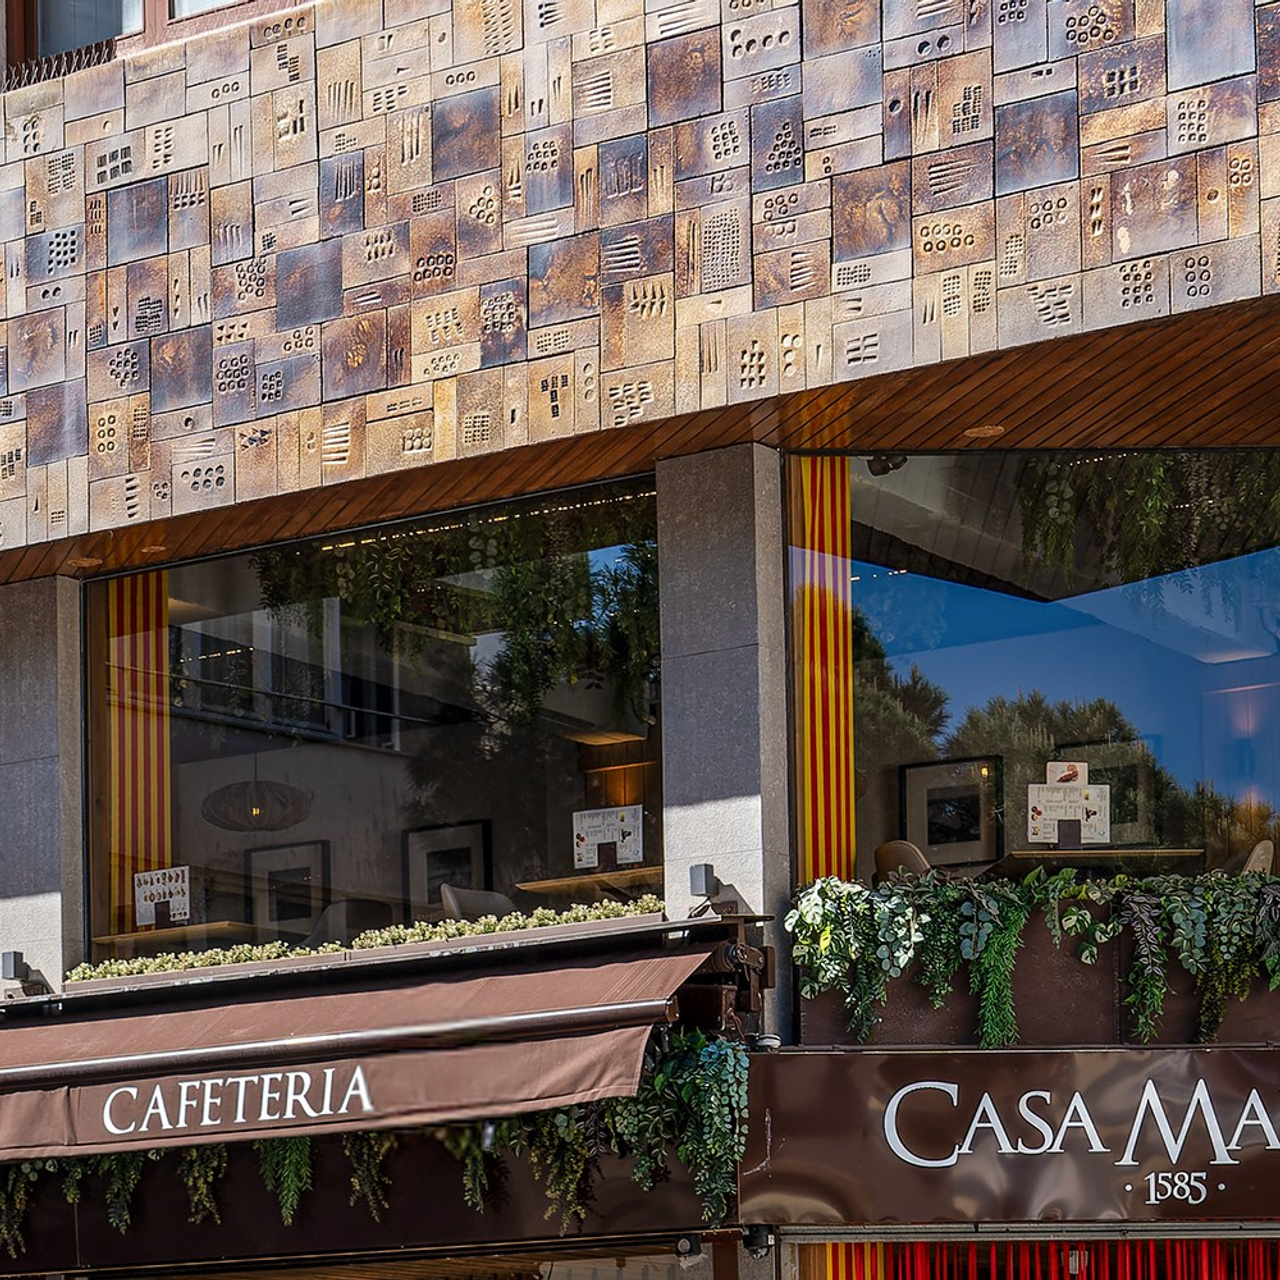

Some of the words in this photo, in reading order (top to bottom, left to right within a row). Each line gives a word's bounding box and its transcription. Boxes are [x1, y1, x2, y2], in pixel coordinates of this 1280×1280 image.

[102, 1065, 375, 1135] CAFETERIA
[883, 1080, 1111, 1168] CASA
[1144, 1172, 1208, 1205] 1585
